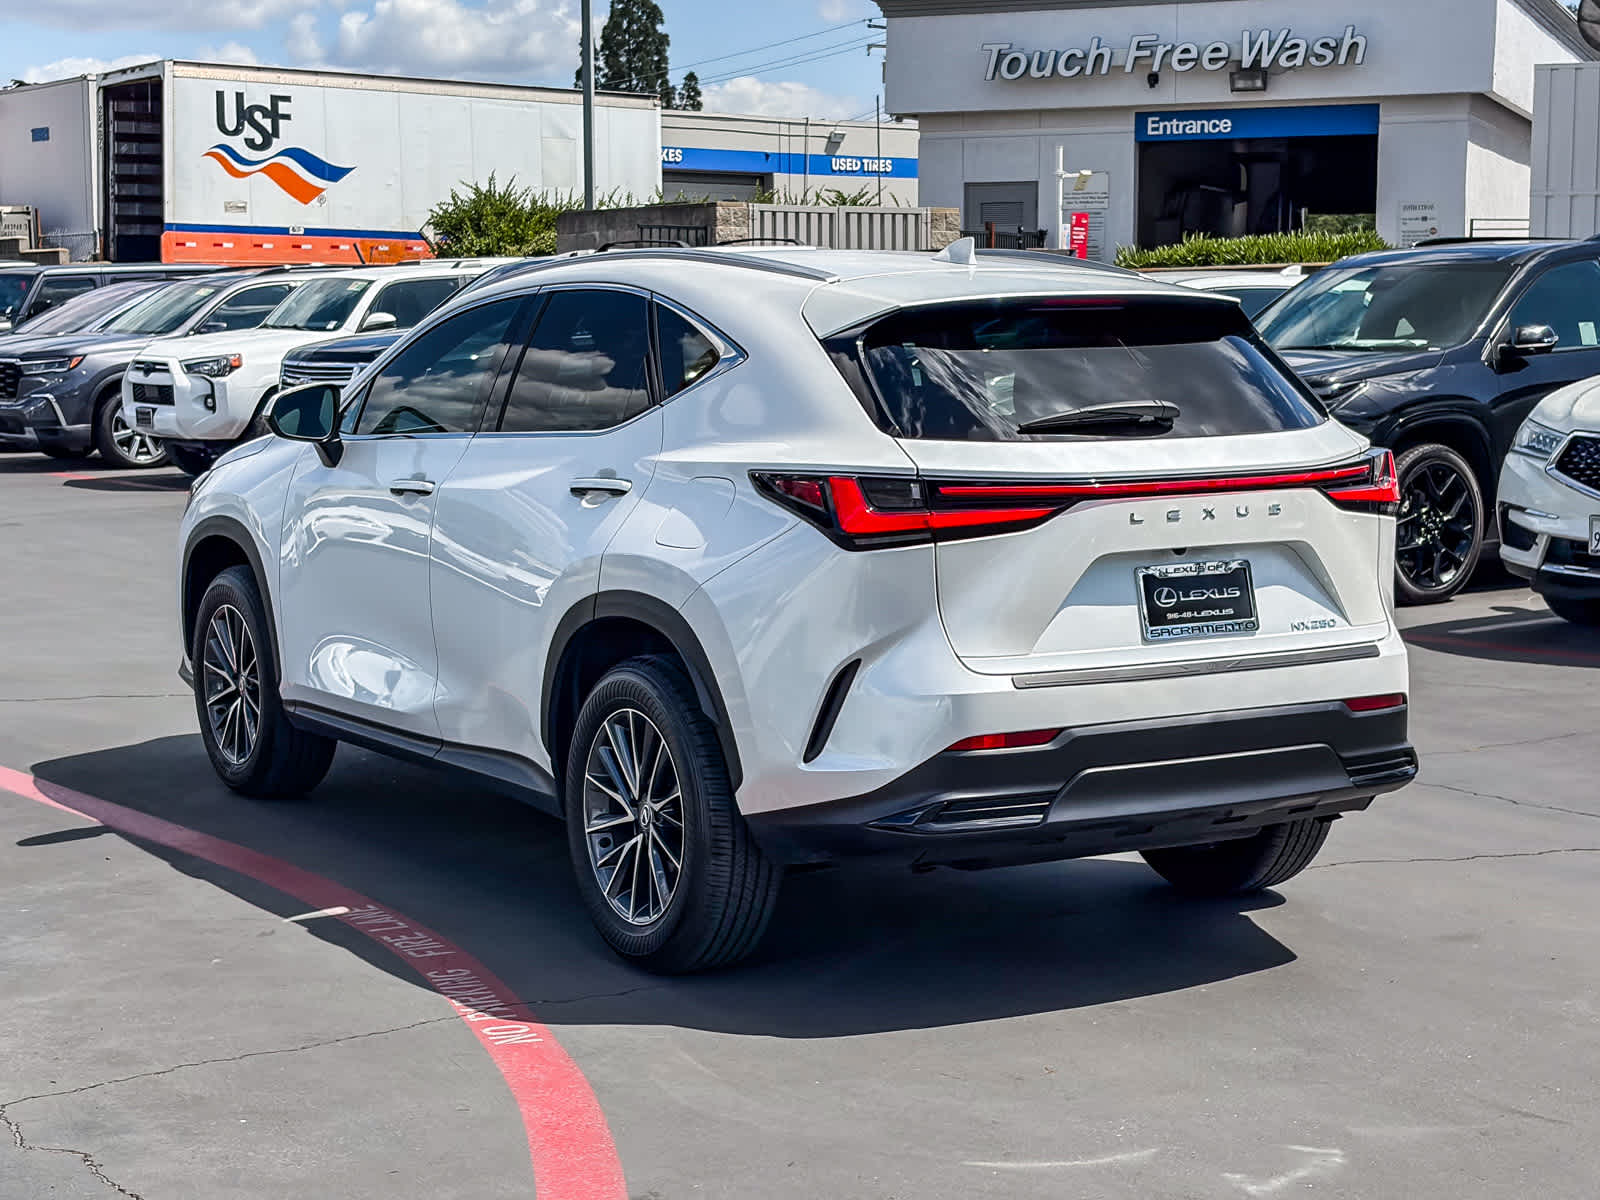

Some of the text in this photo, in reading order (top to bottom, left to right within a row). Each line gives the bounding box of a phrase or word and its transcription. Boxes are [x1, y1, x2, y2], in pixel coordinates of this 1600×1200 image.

[982, 25, 1368, 81] Touch Free Wash
[216, 90, 292, 151] USF
[1147, 116, 1233, 136] Entrance
[831, 157, 893, 173] USED TIRES
[1129, 503, 1283, 526] LEXUS
[1165, 560, 1225, 575] LEXUS OF
[1179, 586, 1241, 602] LEXUS
[1150, 621, 1256, 638] SACRAMENTO
[343, 904, 544, 1046] NO PARKING FIRE LANE
